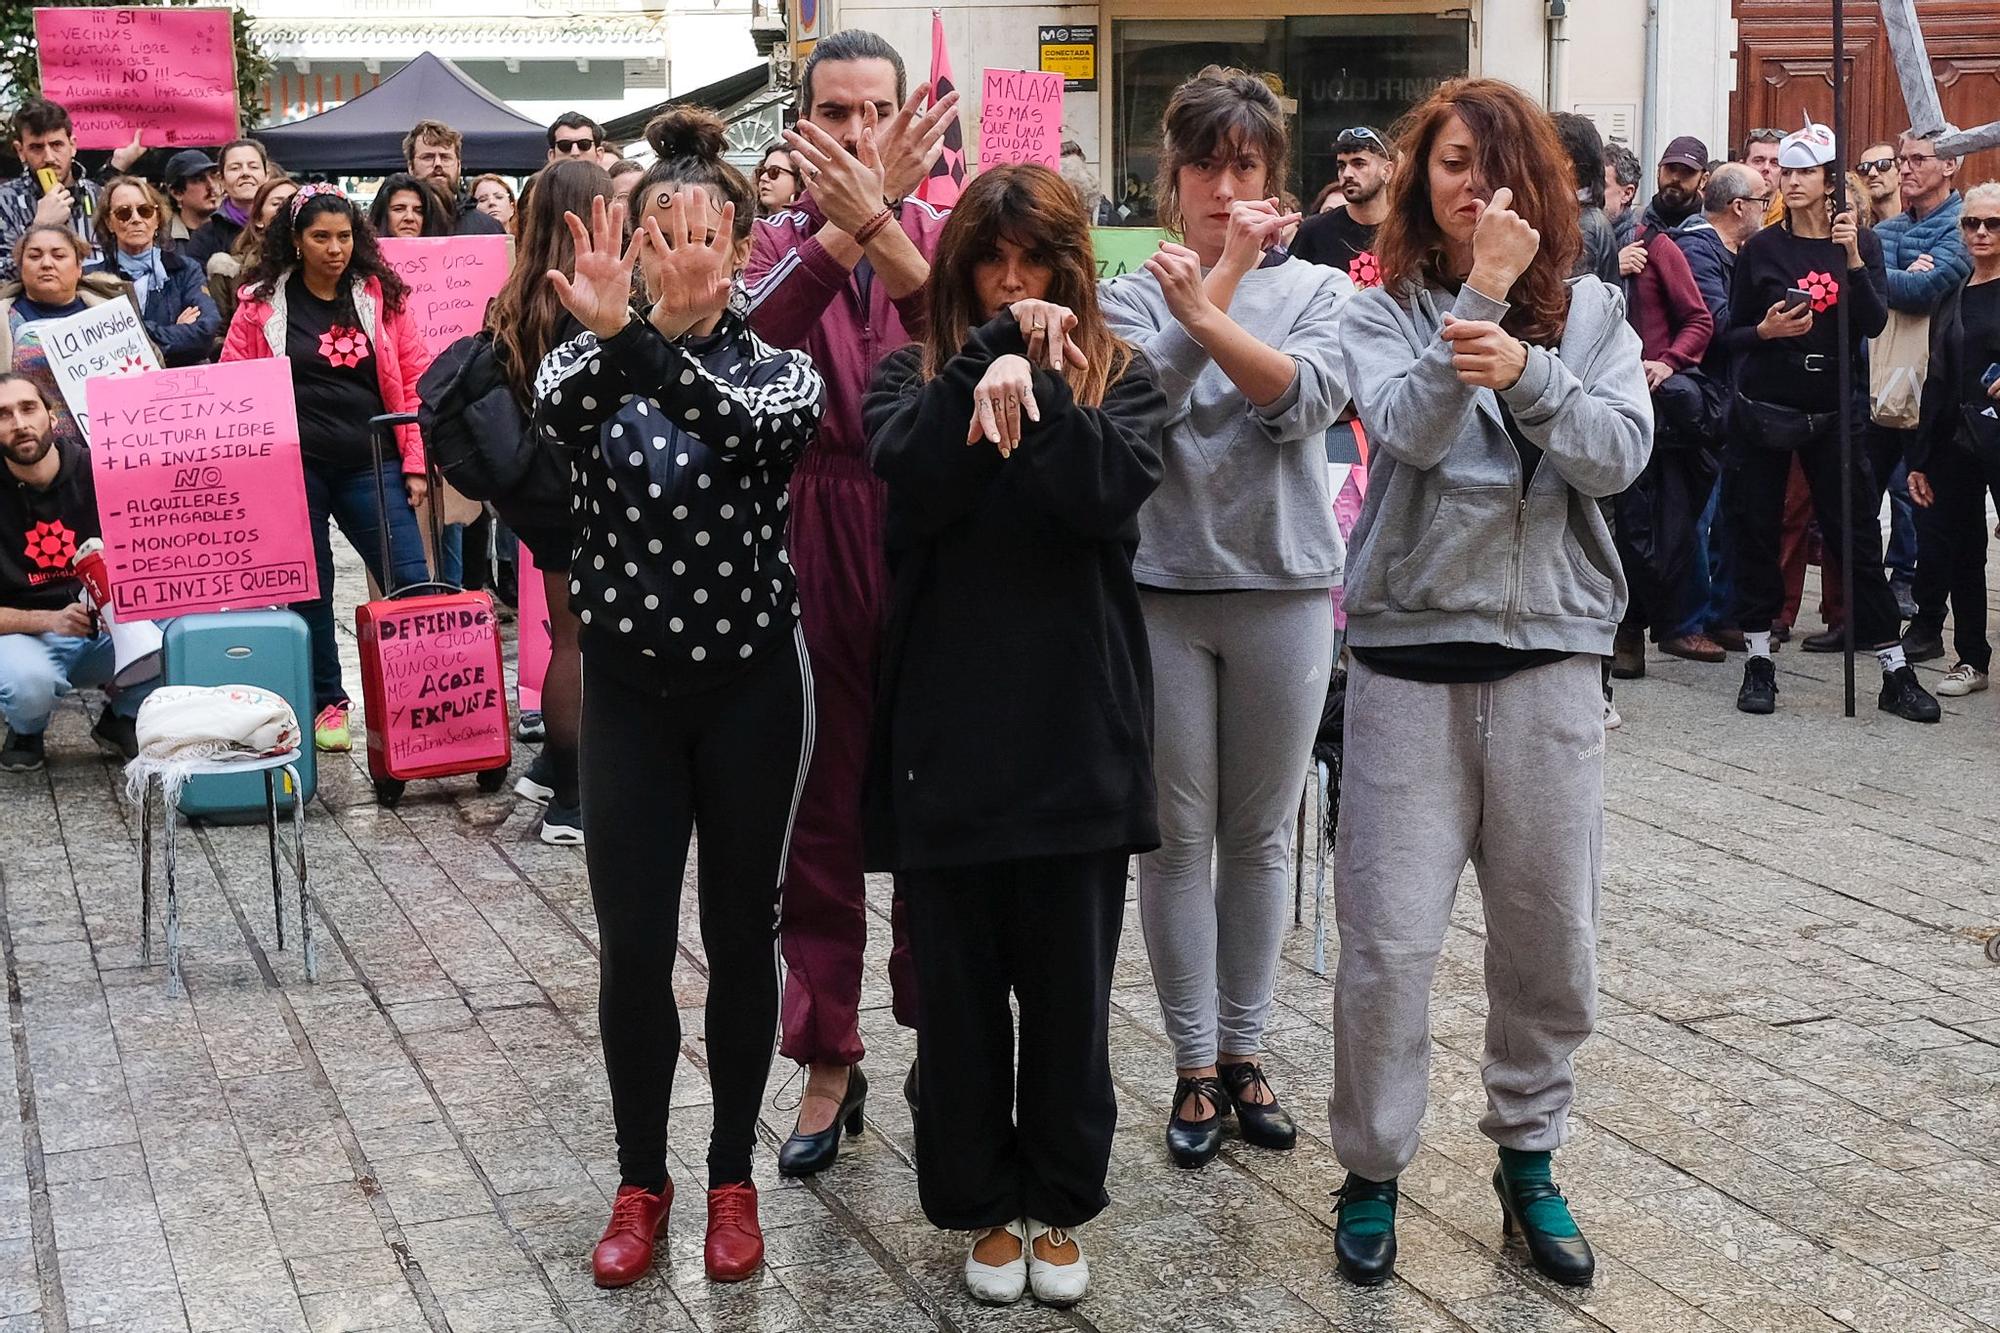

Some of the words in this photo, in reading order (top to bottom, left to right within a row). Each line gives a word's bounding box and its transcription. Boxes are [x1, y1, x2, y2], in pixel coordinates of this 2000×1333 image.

[63, 58, 80, 67] LA
[90, 56, 155, 66] INVISIBLE
[122, 68, 148, 83] NO
[985, 104, 1003, 117] ES
[1009, 104, 1042, 123] MÁS
[983, 120, 1010, 135] QUE
[1016, 124, 1044, 138] UNA
[985, 137, 1042, 151] CIUDAD
[982, 152, 1002, 163] DE
[78, 311, 137, 346] invisible
[68, 363, 88, 381] no
[90, 355, 109, 371] se
[154, 370, 208, 397] SI
[122, 398, 255, 425] VECINXS
[122, 428, 206, 448] CULTURA
[215, 422, 276, 440] LIBRE
[124, 452, 151, 470] LA
[161, 442, 274, 466] INVISIBLE
[175, 466, 222, 488] NO
[127, 491, 240, 514] ALQUILERES
[130, 508, 246, 529] IMPAGABLES
[132, 528, 259, 553] MONOPOLIOS
[132, 549, 253, 573] DESALOJOS
[118, 585, 147, 609] LA
[240, 569, 301, 592] QUEDA
[383, 640, 426, 661] ESTA
[434, 626, 494, 649] CIUDAD
[418, 666, 485, 698] ACOSE
[391, 705, 406, 728] Y
